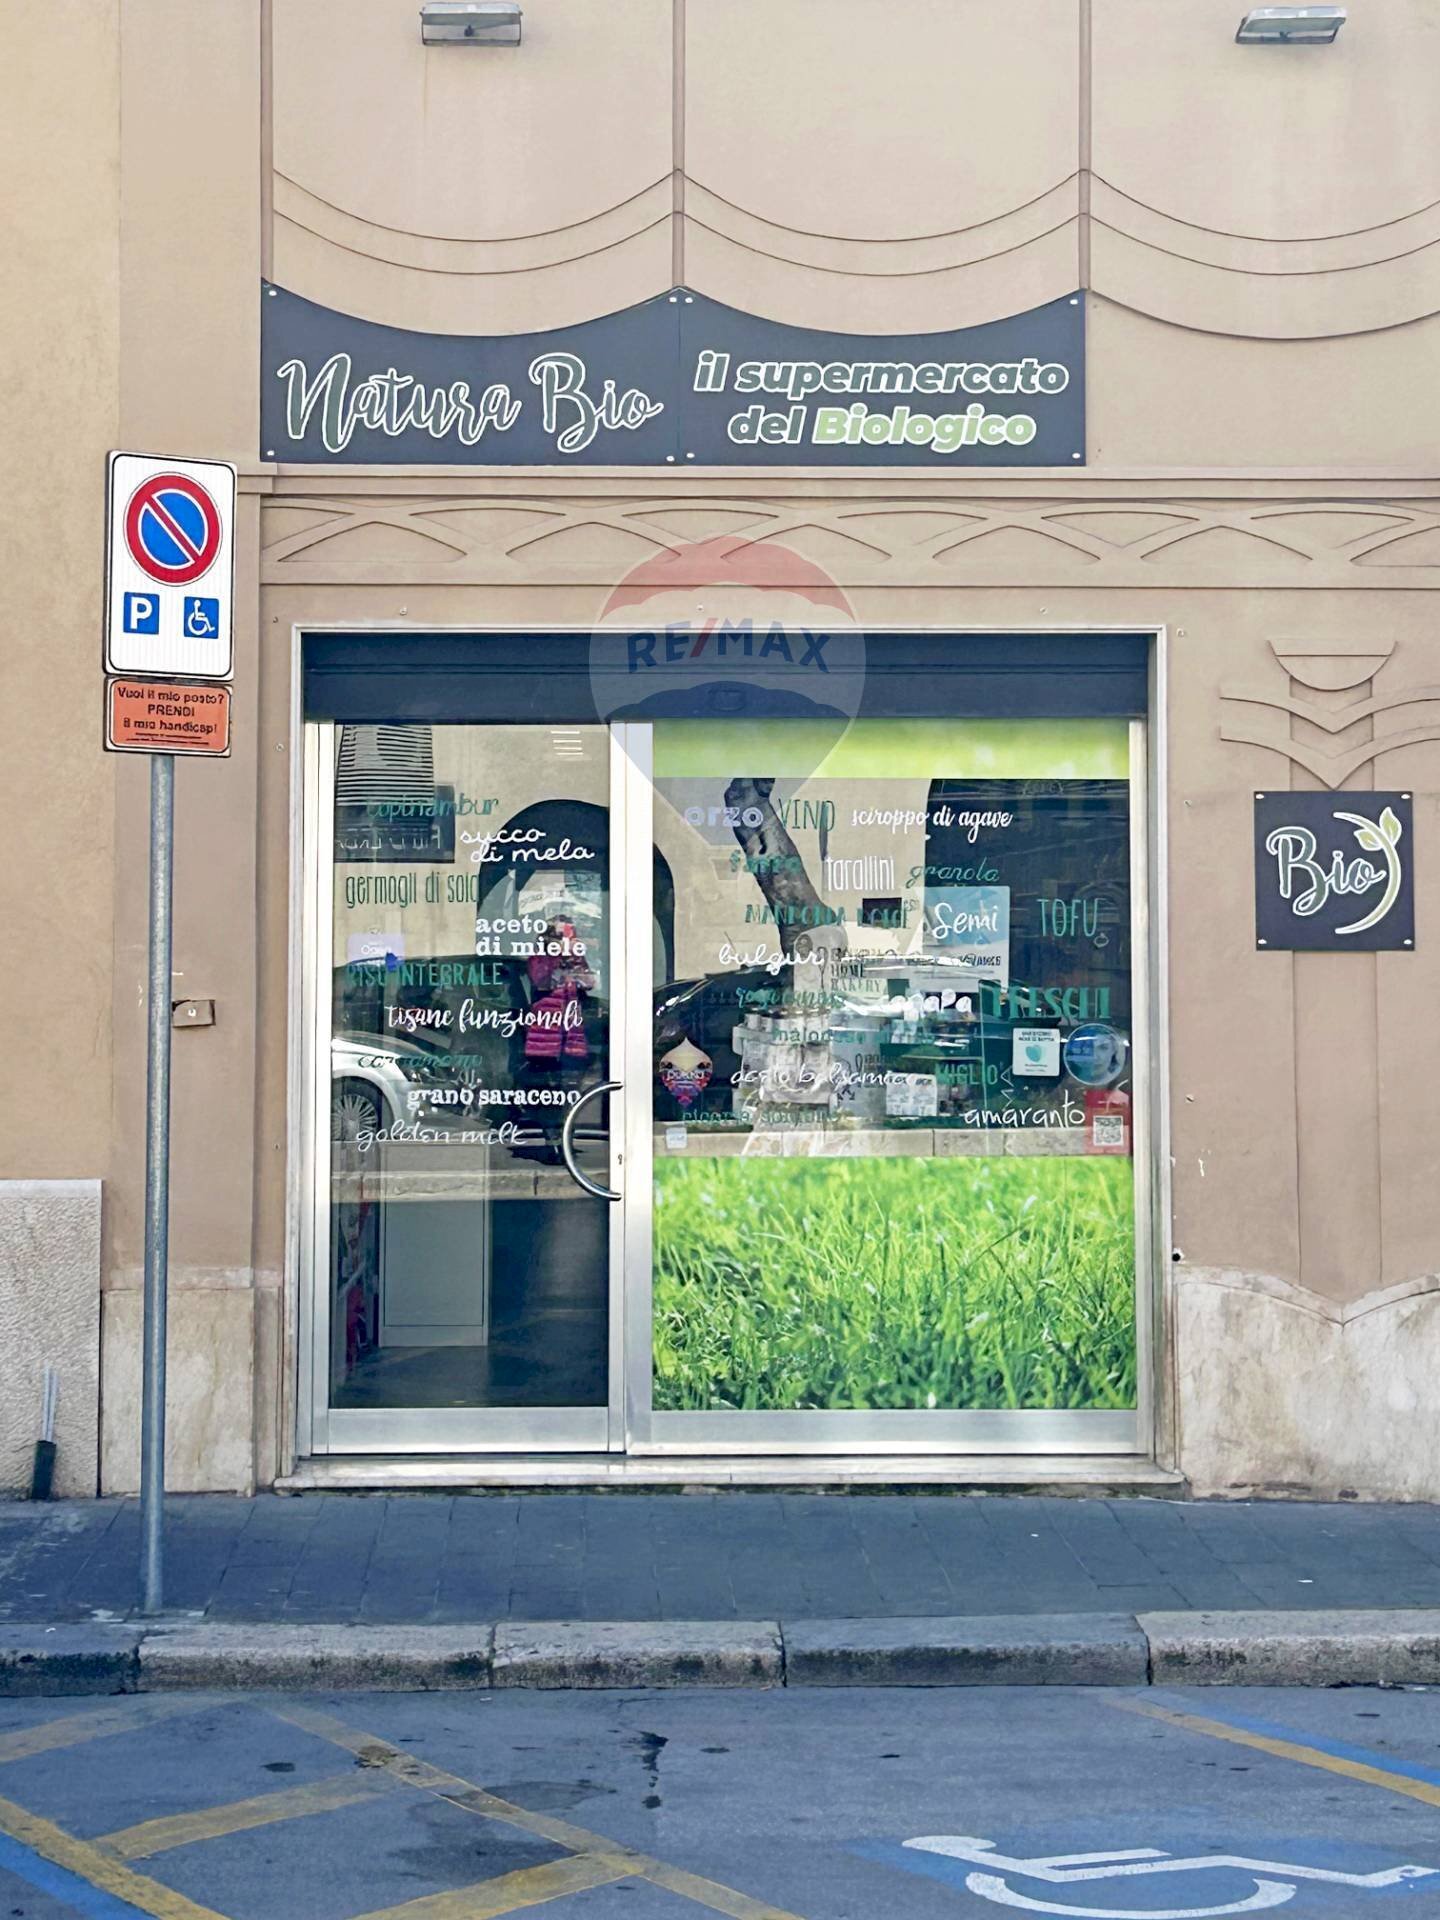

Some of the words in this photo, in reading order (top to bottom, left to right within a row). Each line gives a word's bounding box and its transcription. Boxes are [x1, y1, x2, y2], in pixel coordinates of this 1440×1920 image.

[693, 350, 729, 394] il
[735, 355, 1070, 402] supermercato
[276, 351, 522, 453] Natura
[528, 351, 666, 454] Bio
[727, 404, 806, 444] del
[812, 403, 1038, 453] Biologico
[130, 596, 153, 630] P
[117, 686, 144, 699] Vuoi
[158, 690, 181, 702] mio
[183, 693, 224, 706] posto?
[147, 704, 195, 717] PRENDI
[134, 719, 156, 729] mio
[683, 806, 764, 828] orzo
[852, 806, 928, 836] sciroppo
[932, 805, 954, 827] di
[958, 810, 1013, 844] agave
[470, 842, 504, 862] di
[511, 838, 595, 862] mela
[345, 873, 417, 909] germogli
[424, 870, 441, 904] di
[826, 856, 895, 892] tarallini
[905, 857, 1000, 889] granola
[1265, 826, 1388, 917] Bio
[475, 917, 548, 935] aceto
[932, 902, 999, 940] Semi
[1037, 898, 1101, 938] TOFU
[475, 937, 507, 957] di
[511, 936, 588, 957] miele
[964, 1088, 1086, 1129] amaranto
